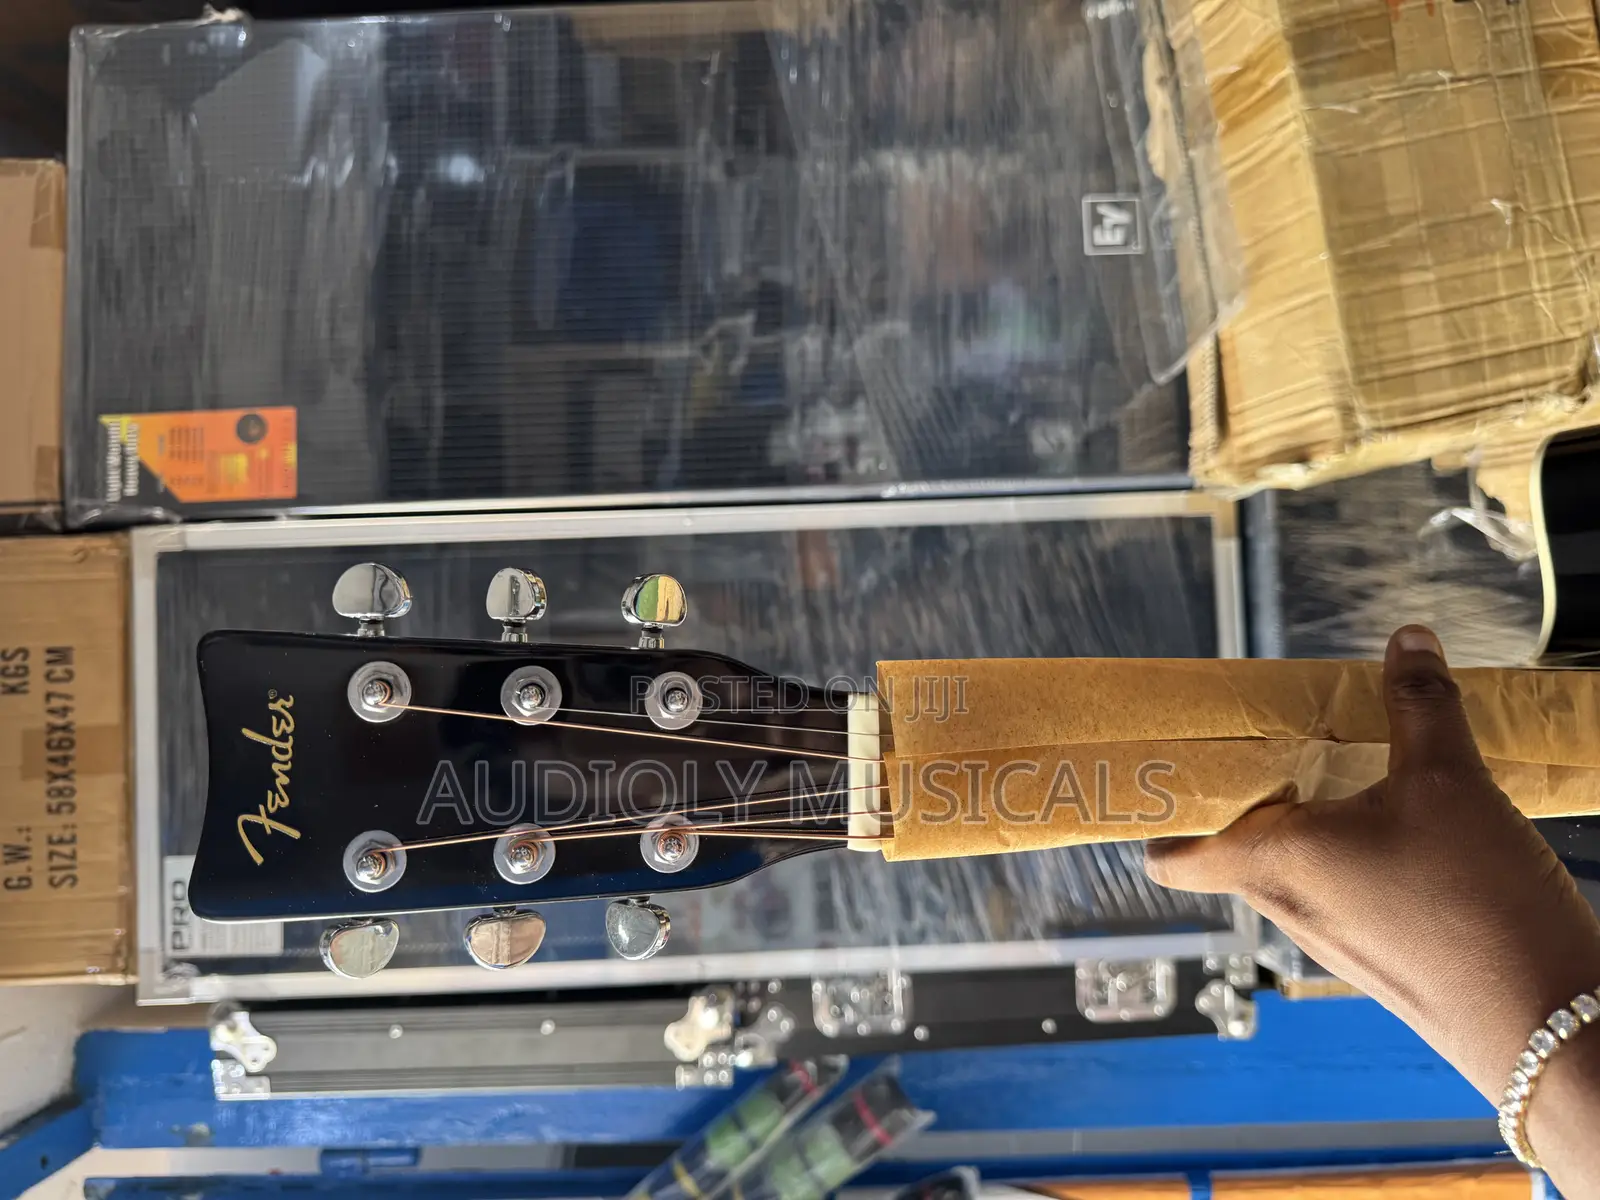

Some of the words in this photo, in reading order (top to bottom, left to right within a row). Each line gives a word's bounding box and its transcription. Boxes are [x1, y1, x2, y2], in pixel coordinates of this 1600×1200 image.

[0, 647, 30, 695] KGS
[45, 646, 75, 684] CM
[46, 690, 76, 815] 58X46X47
[48, 823, 78, 889] SIZE:
[172, 879, 189, 951] PRO
